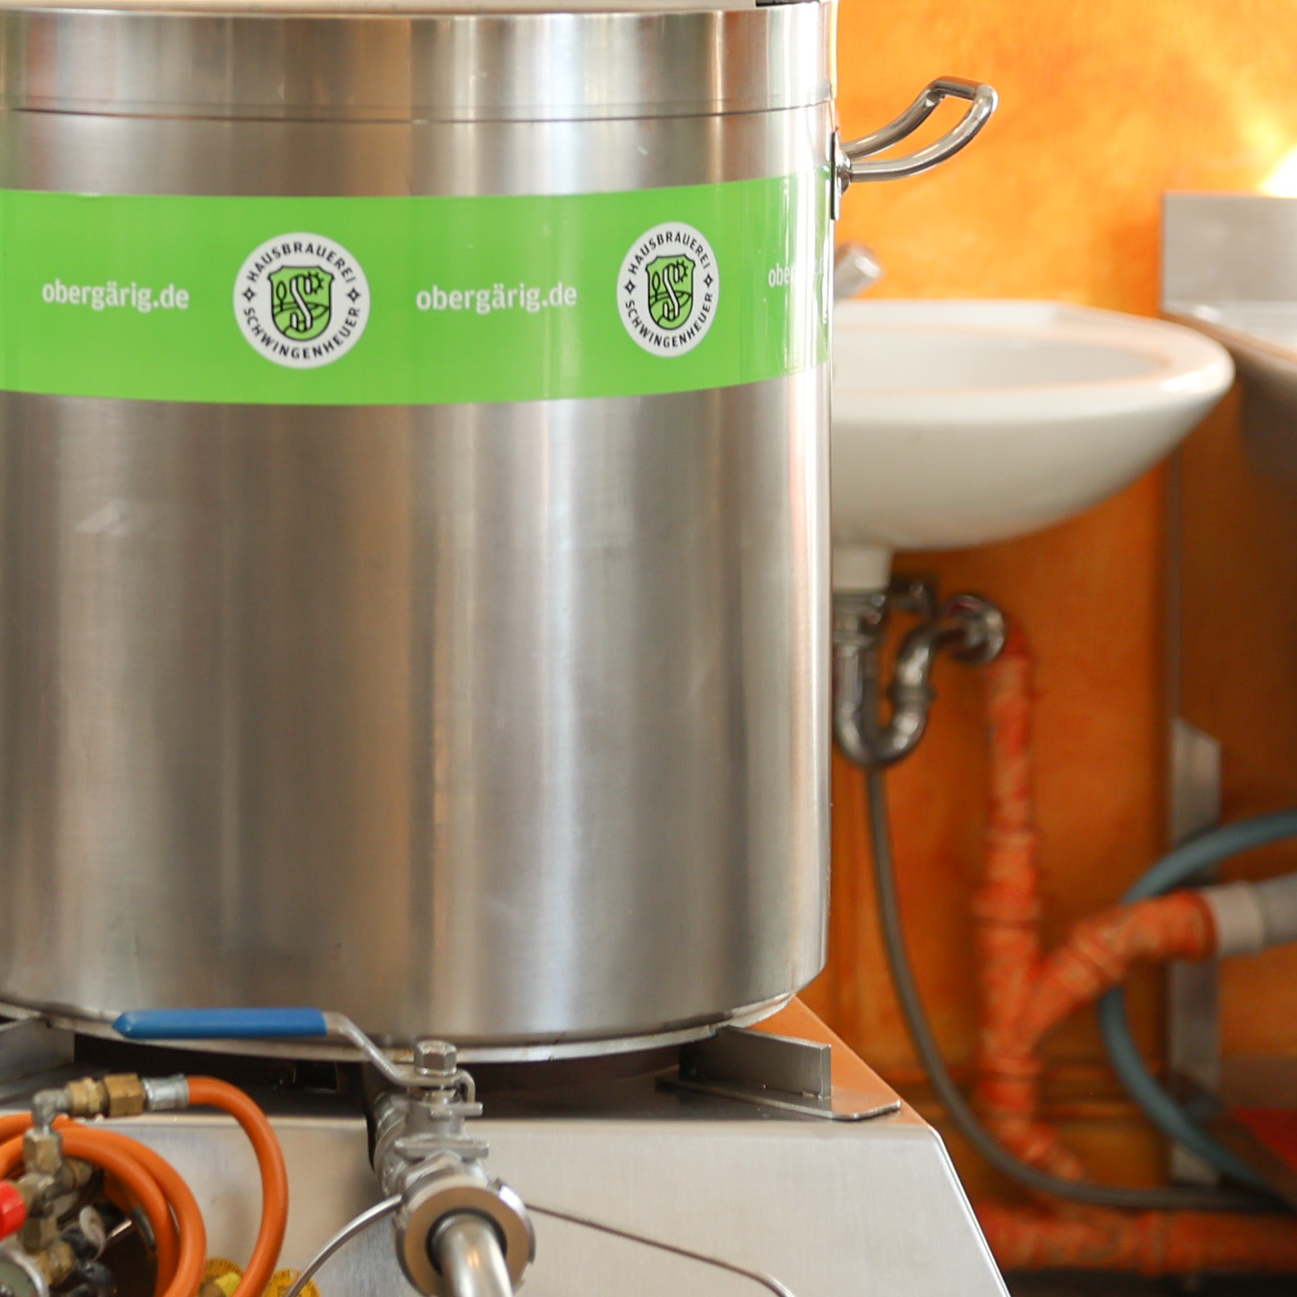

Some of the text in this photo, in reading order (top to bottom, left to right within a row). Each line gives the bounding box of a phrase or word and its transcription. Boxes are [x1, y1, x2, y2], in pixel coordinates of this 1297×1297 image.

[246, 241, 357, 284] HAUSBRAUEREI
[627, 230, 711, 276] HAUSBRAUEREI
[41, 277, 191, 314] obergärig.de
[415, 279, 579, 317] obergärig.de
[243, 305, 361, 360] SCHWINGENHEUER
[624, 292, 714, 349] SCHWINGENHEUER
